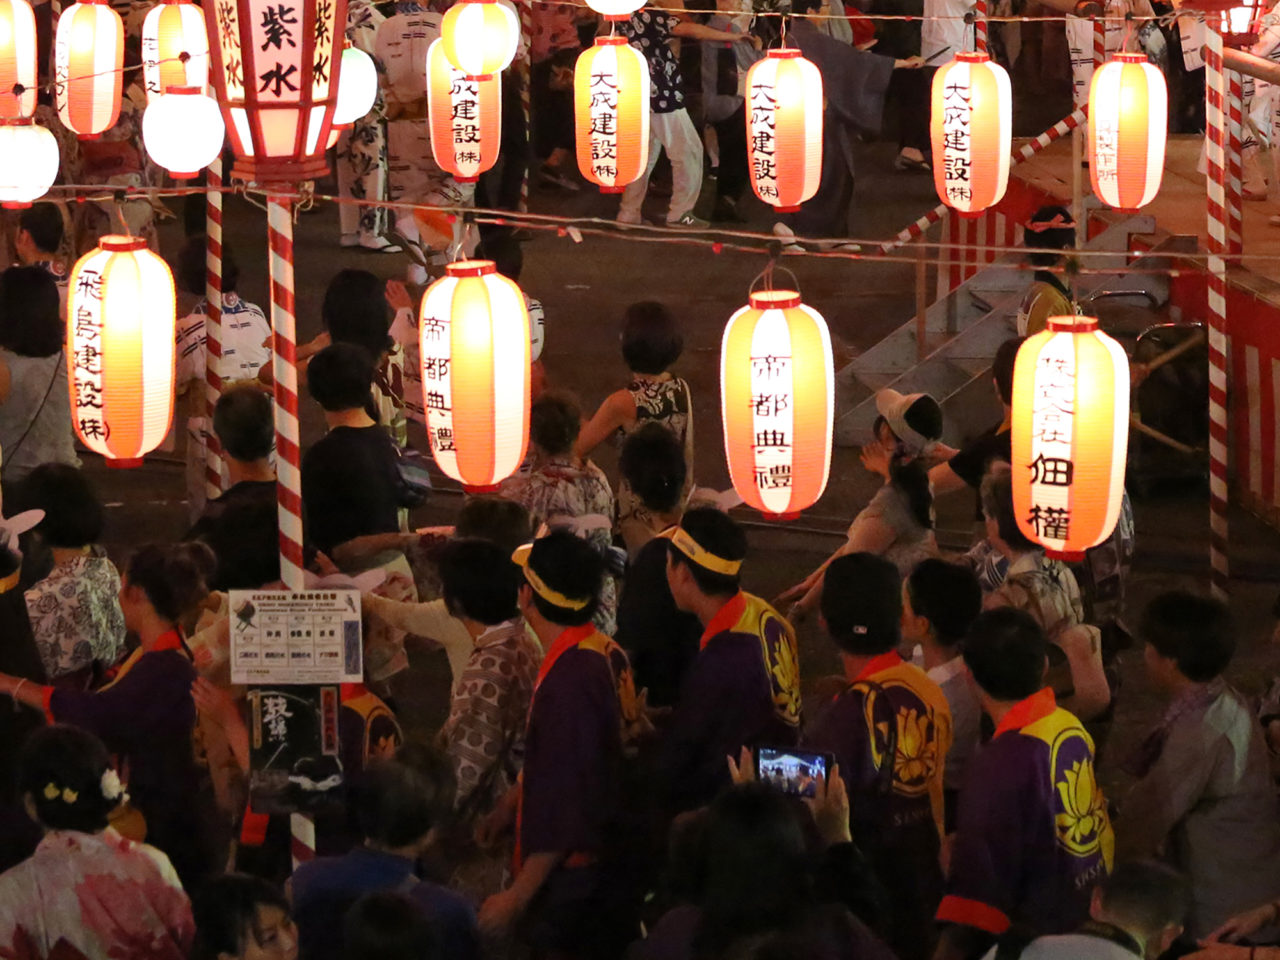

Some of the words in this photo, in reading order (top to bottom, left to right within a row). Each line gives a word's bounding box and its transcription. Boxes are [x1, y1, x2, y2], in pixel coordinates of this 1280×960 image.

[218, 1, 244, 88] 紫水
[258, 3, 302, 96] 紫水
[449, 66, 483, 166] 成建設(株)
